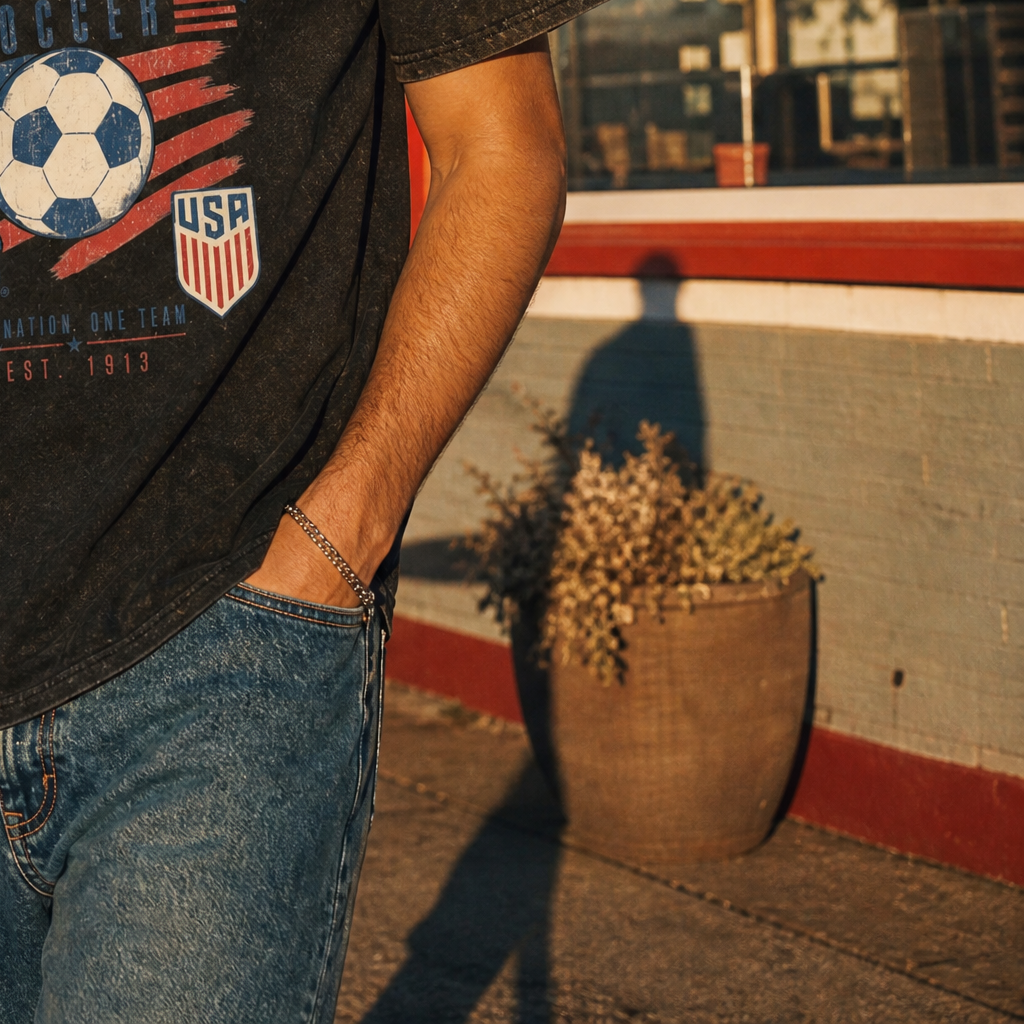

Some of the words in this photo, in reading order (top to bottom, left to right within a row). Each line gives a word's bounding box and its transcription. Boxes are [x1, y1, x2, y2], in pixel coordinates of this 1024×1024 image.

[178, 193, 249, 240] USA
[91, 309, 126, 333] ONE
[138, 304, 187, 328] TEAM
[6, 358, 63, 383] EST.
[87, 351, 150, 376] 1913
